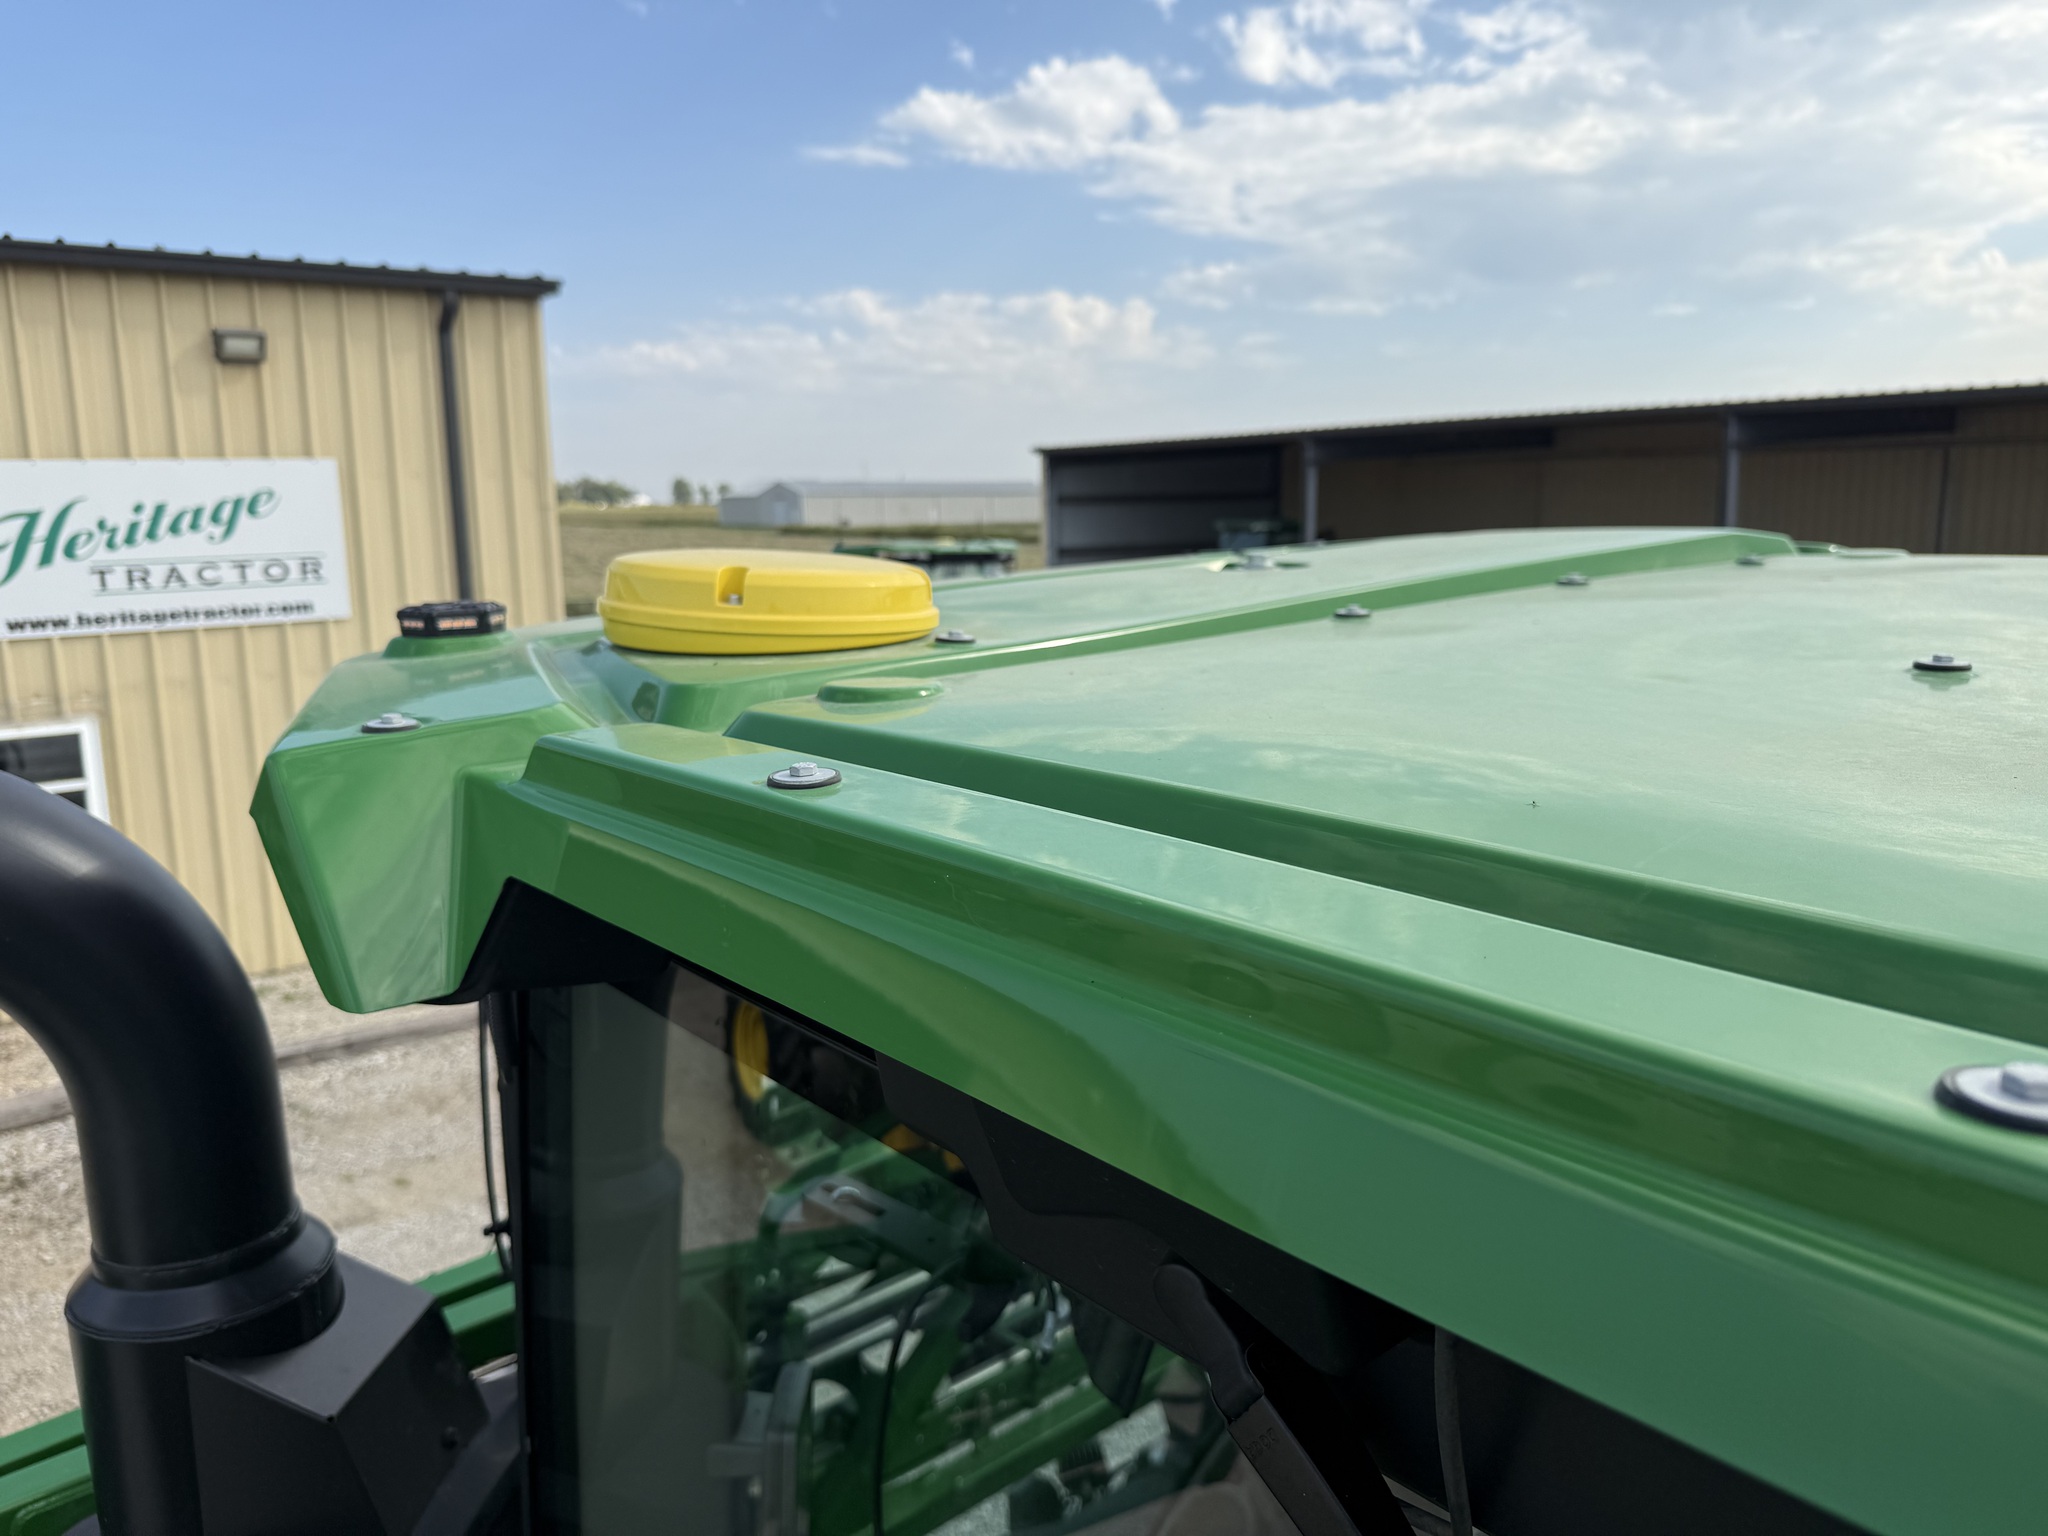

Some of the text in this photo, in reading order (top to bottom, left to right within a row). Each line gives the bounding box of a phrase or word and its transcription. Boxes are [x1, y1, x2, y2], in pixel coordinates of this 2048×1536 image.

[0, 486, 278, 587] Heritage
[91, 556, 325, 592] TRACTOR
[6, 600, 315, 633] www.heritagetractor.com
